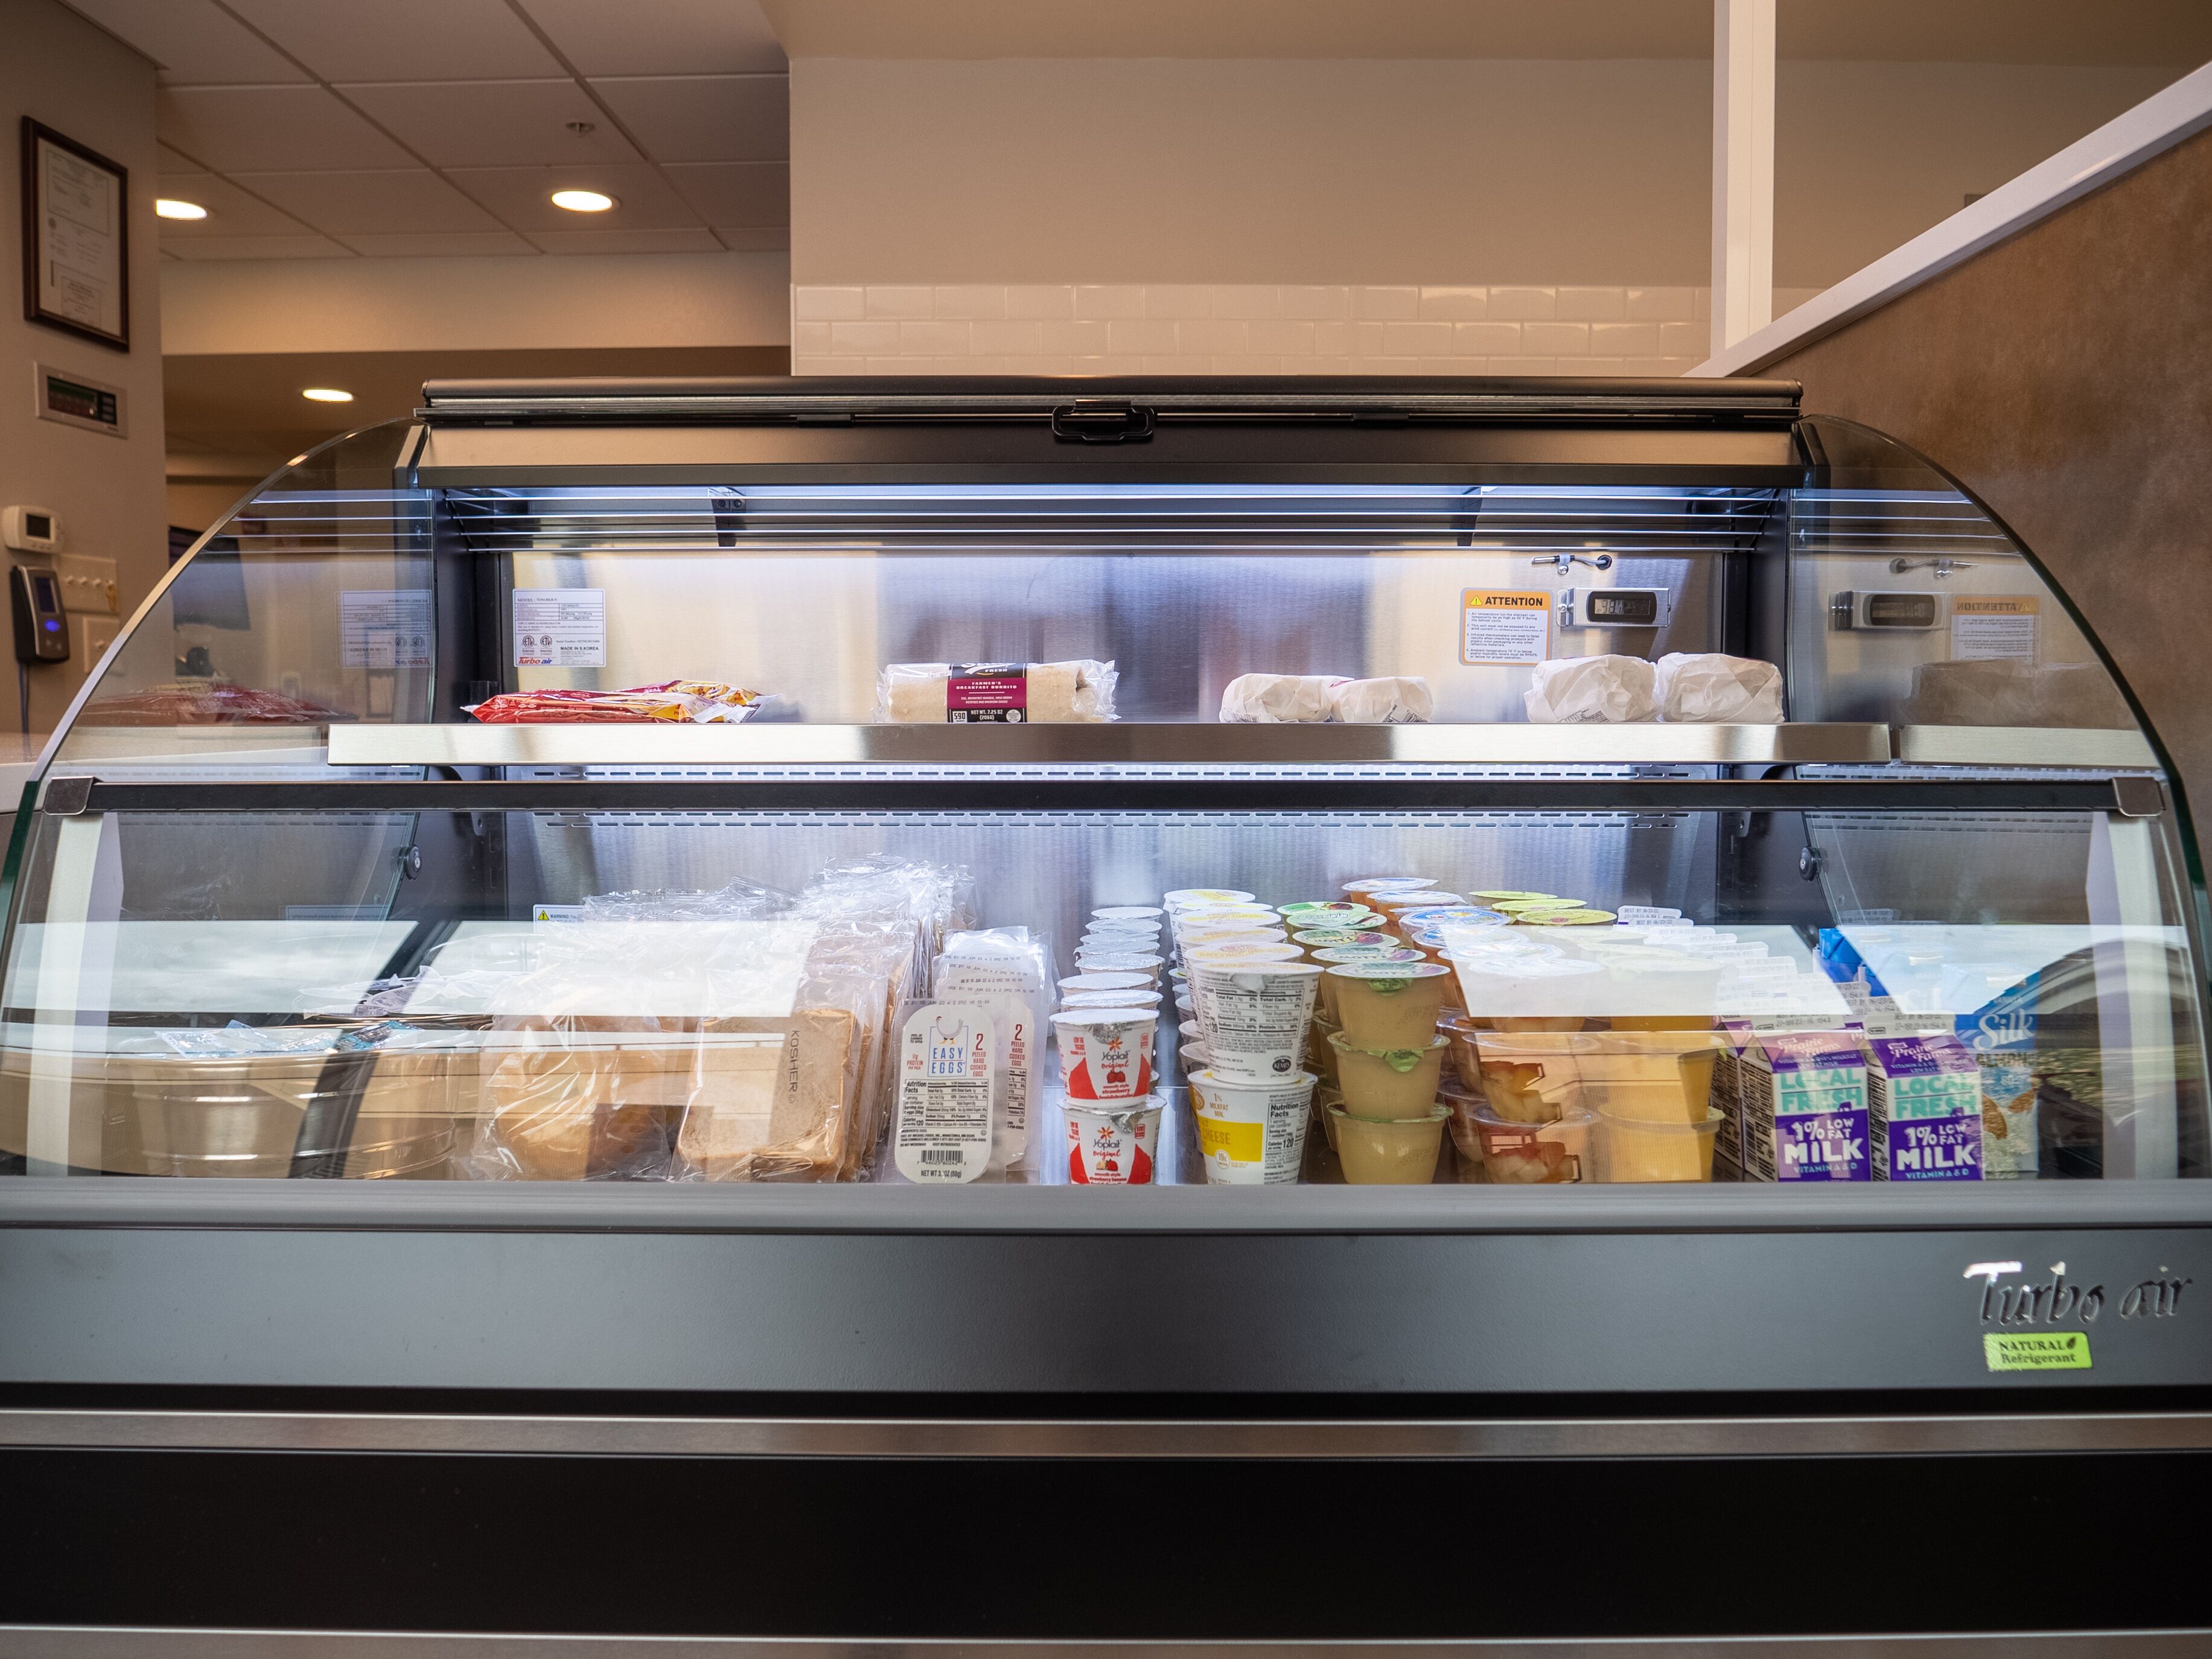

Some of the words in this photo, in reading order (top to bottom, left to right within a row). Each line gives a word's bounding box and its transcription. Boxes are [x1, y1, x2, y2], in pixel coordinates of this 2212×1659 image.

[1485, 597, 1543, 606] ATTENTION
[1014, 1024, 1022, 1041] 2
[1210, 1024, 1218, 1033] 120
[1972, 1008, 2035, 1051] Silk
[975, 1033, 984, 1051] 2
[1781, 1037, 1823, 1054] Prairie
[933, 1047, 963, 1059] EASY
[1101, 1050, 1129, 1063] Yoplait
[1800, 1042, 1841, 1057] Farms
[1890, 1044, 1933, 1058] Prairie
[1913, 1048, 1952, 1062] Farms
[788, 1029, 800, 1093] KOSHER
[932, 1062, 963, 1074] EGGS
[1101, 1060, 1129, 1071] Original
[1780, 1068, 1861, 1090] LOCAL
[1894, 1074, 1974, 1096] LOCAL
[1214, 1093, 1222, 1102] 1%
[1782, 1088, 1863, 1112] FRESH
[1210, 1103, 1229, 1111] MILKFAT
[1896, 1095, 1977, 1119] FRESH
[1202, 1128, 1231, 1145] CHEESE
[1791, 1121, 1825, 1141] 1%
[1827, 1118, 1855, 1130] LOW
[1828, 1129, 1852, 1140] FAT
[1904, 1125, 1937, 1147] 1%
[1939, 1124, 1967, 1135] LOW
[1093, 1139, 1121, 1151] Yoplait
[1283, 1138, 1294, 1148] 120
[1939, 1134, 1964, 1145] FAT
[1093, 1149, 1121, 1161] Original
[1783, 1138, 1865, 1165] MILK
[1896, 1144, 1977, 1171] MILK
[1793, 1164, 1832, 1174] VITAMIN
[1905, 1170, 1945, 1180] VITAMIN
[1963, 1261, 2105, 1326] Turbo
[2120, 1266, 2193, 1320] air
[1999, 1340, 2066, 1351] NATURAL
[2001, 1352, 2077, 1365] Refrigerant
